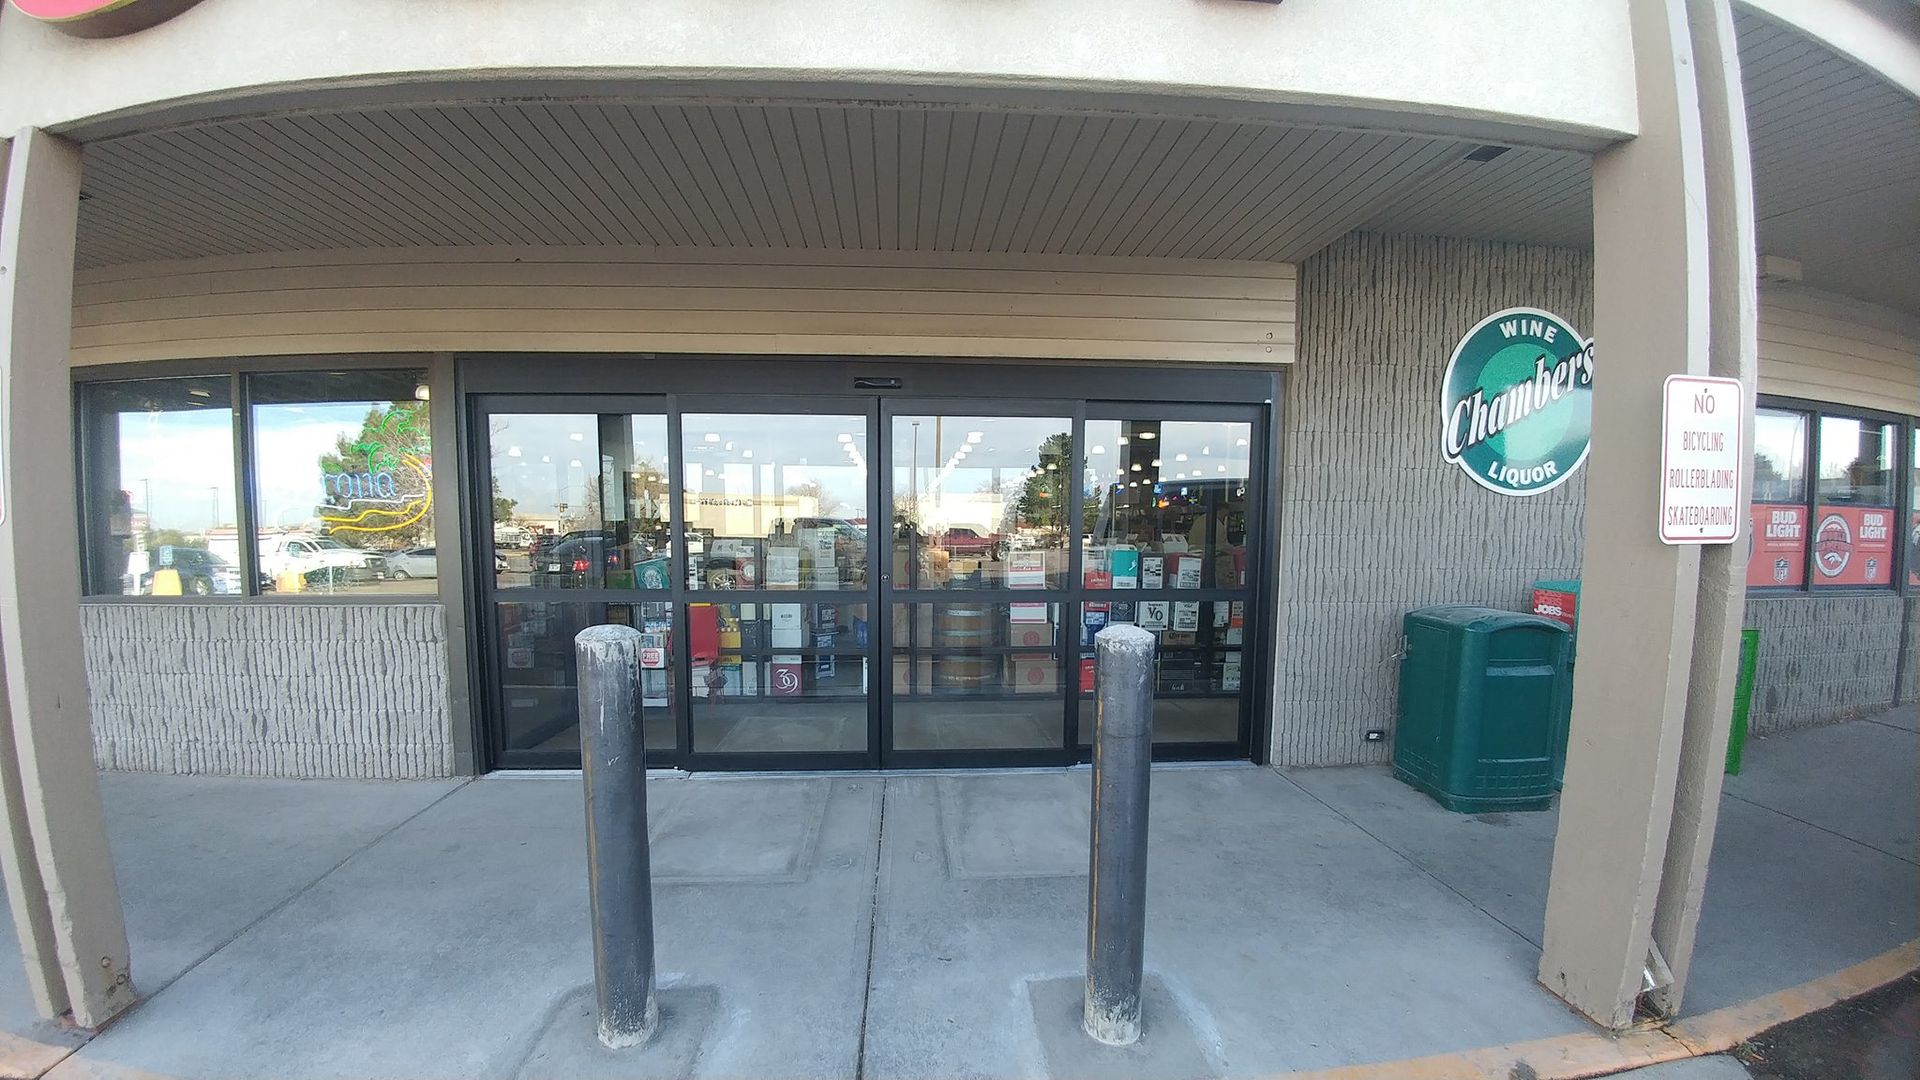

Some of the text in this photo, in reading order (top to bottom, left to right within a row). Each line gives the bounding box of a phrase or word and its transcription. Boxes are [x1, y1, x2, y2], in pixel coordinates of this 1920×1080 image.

[1499, 319, 1558, 344] WINE
[1447, 346, 1593, 454] Chambers
[1694, 394, 1715, 414] NO
[1683, 431, 1724, 452] BICYCLING
[1487, 460, 1559, 487] LIQUOR
[1669, 468, 1734, 489] ROLLERBLADING
[320, 472, 397, 499] rona
[1668, 506, 1733, 526] SKATEBOARDING
[1772, 511, 1796, 524] BUD
[1863, 514, 1884, 525] BUD
[1766, 525, 1801, 538] LIGHT
[1860, 527, 1887, 538] LIGHT
[1534, 604, 1563, 616] JOBS
[643, 652, 659, 660] FREE
[775, 668, 799, 694] 39
